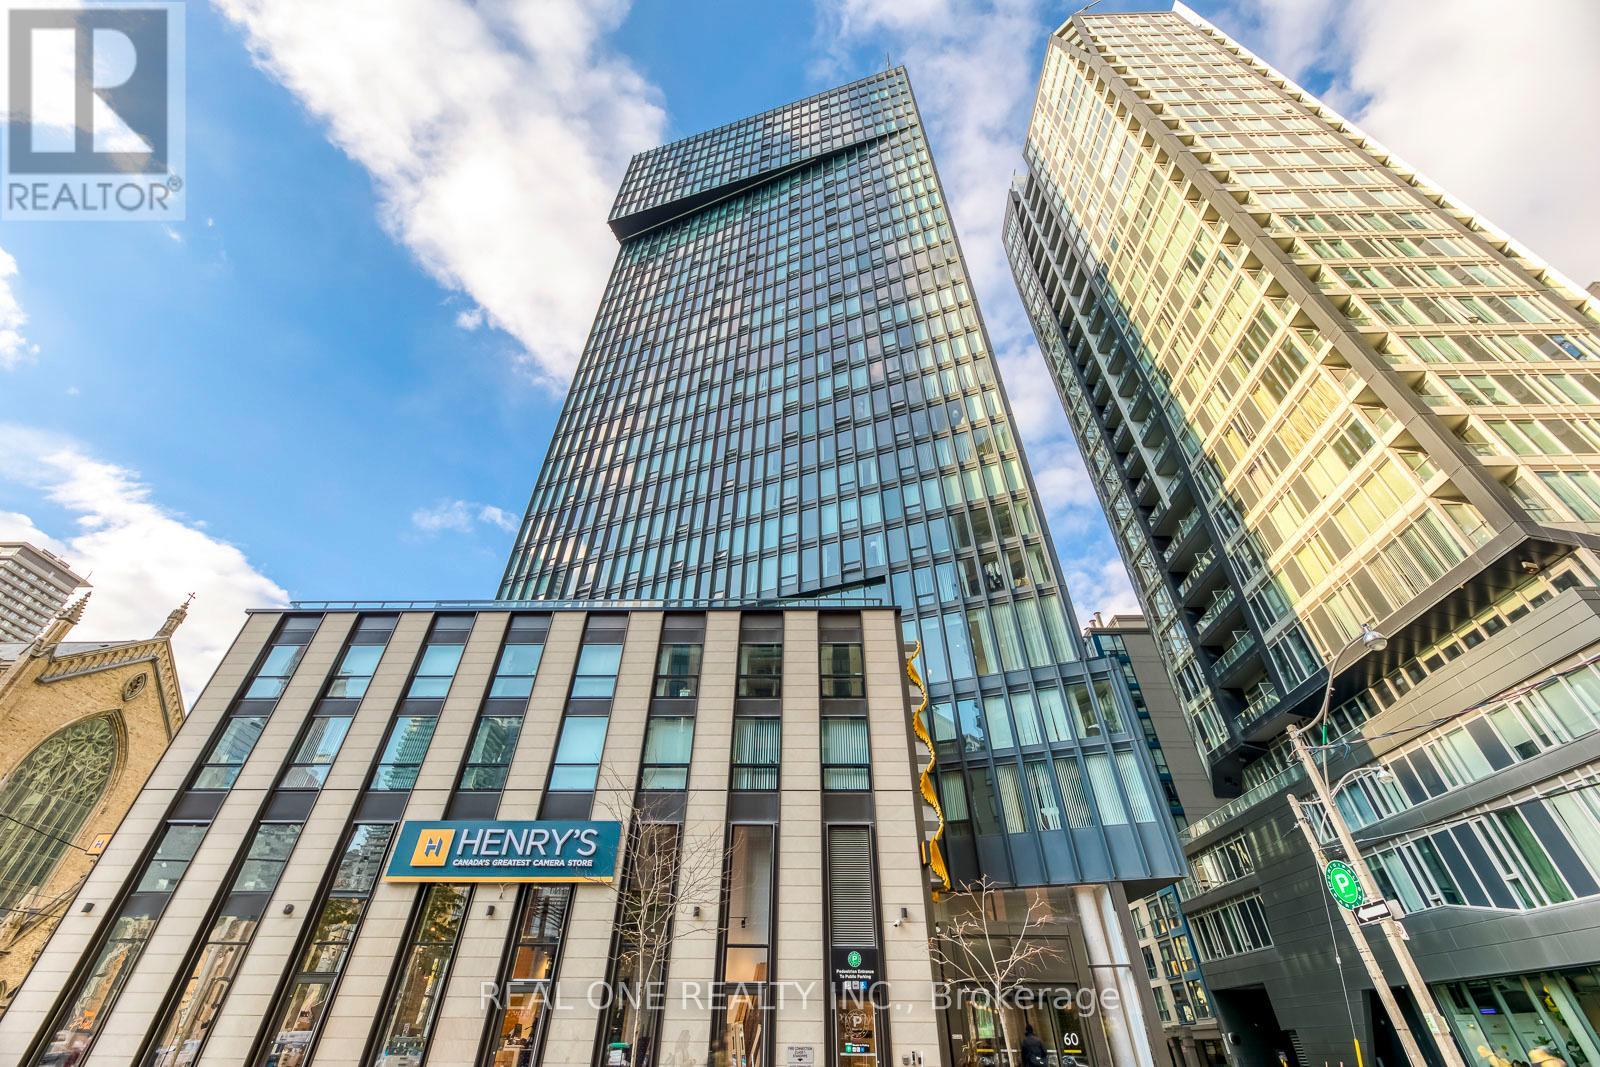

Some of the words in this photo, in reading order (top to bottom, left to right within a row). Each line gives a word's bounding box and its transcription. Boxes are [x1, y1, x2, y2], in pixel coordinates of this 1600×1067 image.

[456, 828, 598, 857] HENRY'S
[452, 858, 490, 867] CANADA'S
[492, 858, 531, 867] GREATEST
[532, 858, 565, 867] CAMERA
[567, 858, 593, 867] STORE
[1334, 873, 1350, 894] P
[1063, 1032, 1079, 1046] 60
